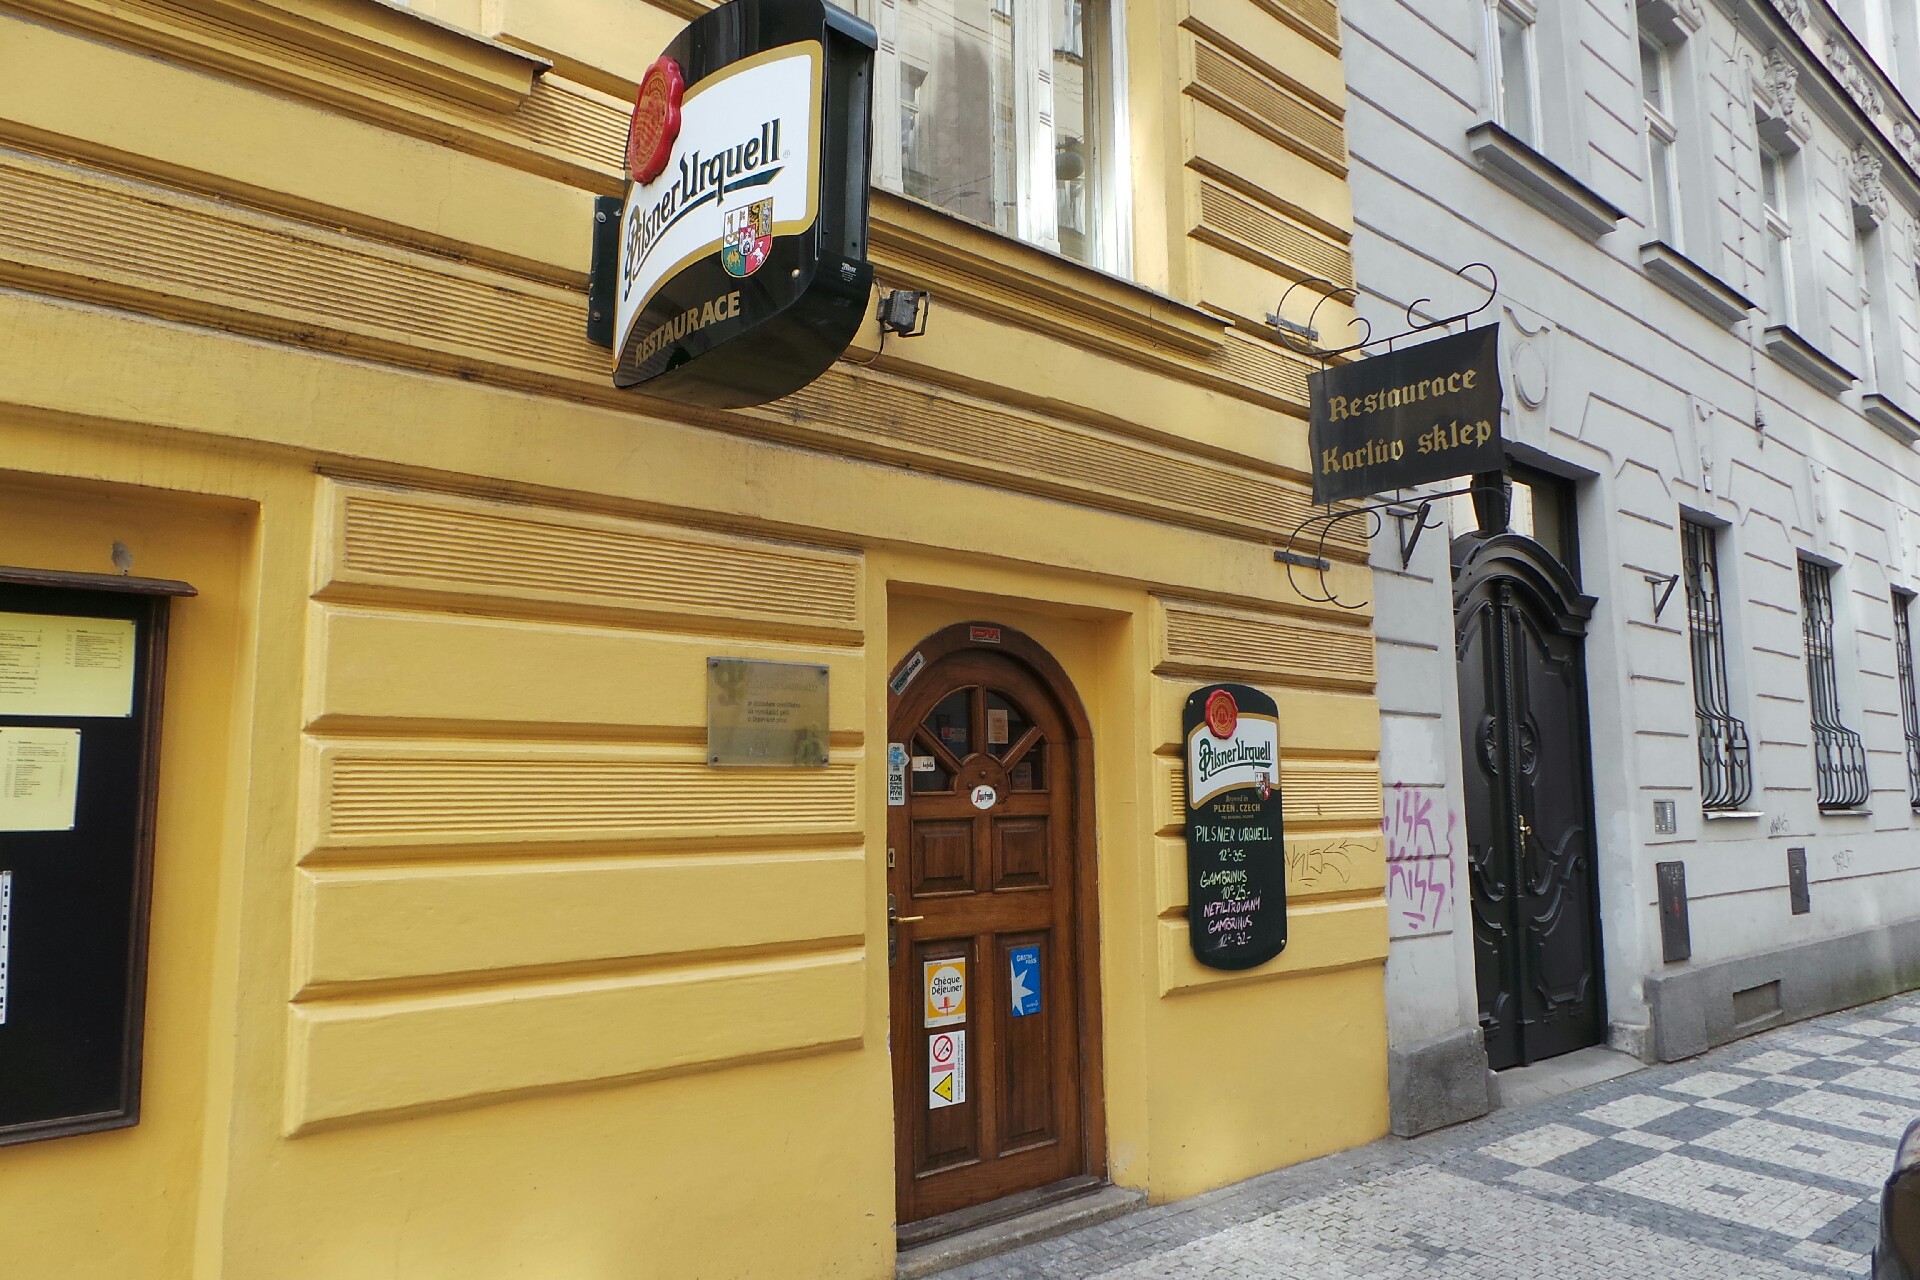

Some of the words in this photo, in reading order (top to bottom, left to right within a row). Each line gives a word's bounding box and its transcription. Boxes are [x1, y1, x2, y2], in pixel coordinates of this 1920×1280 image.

[624, 179, 681, 302] Pilsner
[679, 117, 781, 207] Urquell
[635, 290, 740, 368] RESTAURACE
[1328, 369, 1478, 423] Restaurace
[1321, 438, 1404, 476] Karlův
[1418, 419, 1493, 455] sklep
[1199, 738, 1236, 782] Pilsner
[1235, 737, 1271, 770] Urquell
[1239, 803, 1261, 812] CZECH
[1195, 825, 1236, 842] PILSNER
[1200, 869, 1248, 888] GAMBRINUS
[1208, 914, 1253, 934] GAMBRINUS
[931, 985, 963, 996] Déjeuner
[933, 976, 961, 987] Chèque
